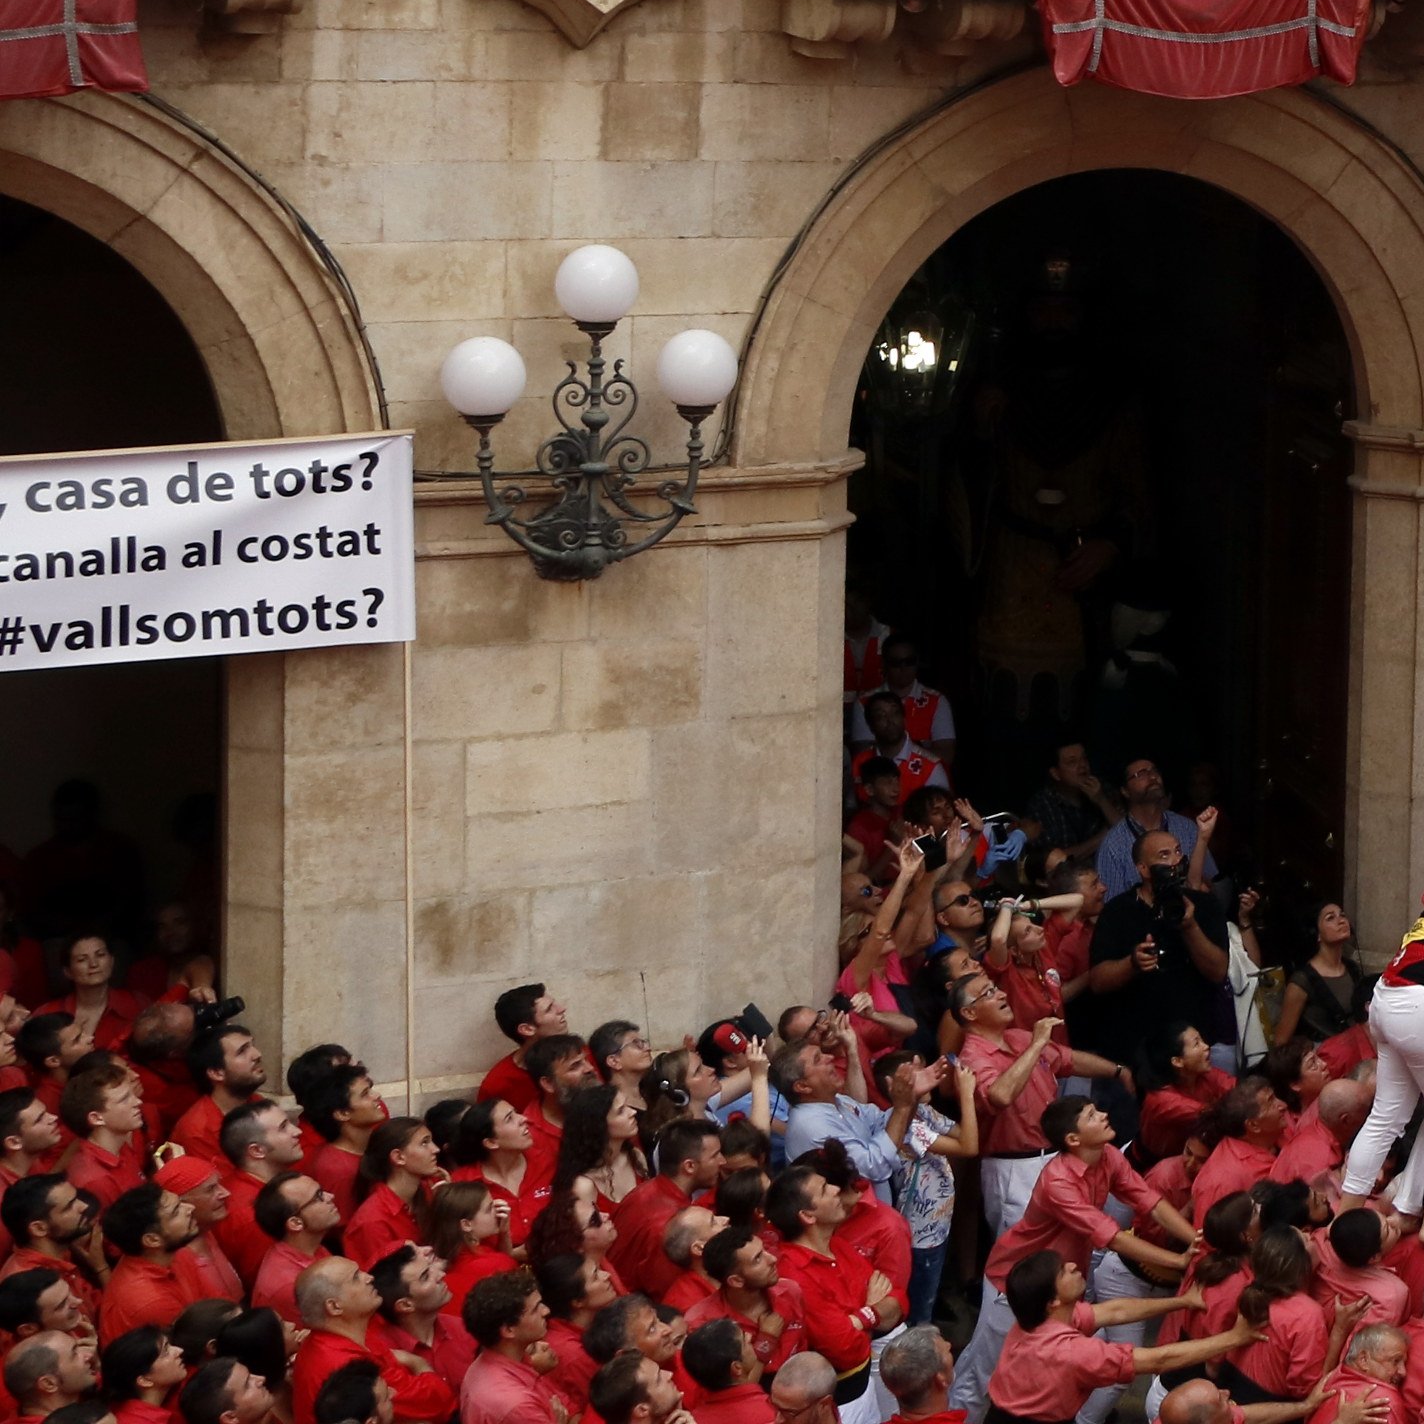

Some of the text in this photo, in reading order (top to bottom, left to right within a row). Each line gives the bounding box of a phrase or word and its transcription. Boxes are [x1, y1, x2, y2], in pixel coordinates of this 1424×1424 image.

[25, 451, 380, 513] casa de tots?
[181, 529, 223, 568] al
[236, 522, 382, 563] costat
[0, 587, 385, 656] #vallsomtots?
